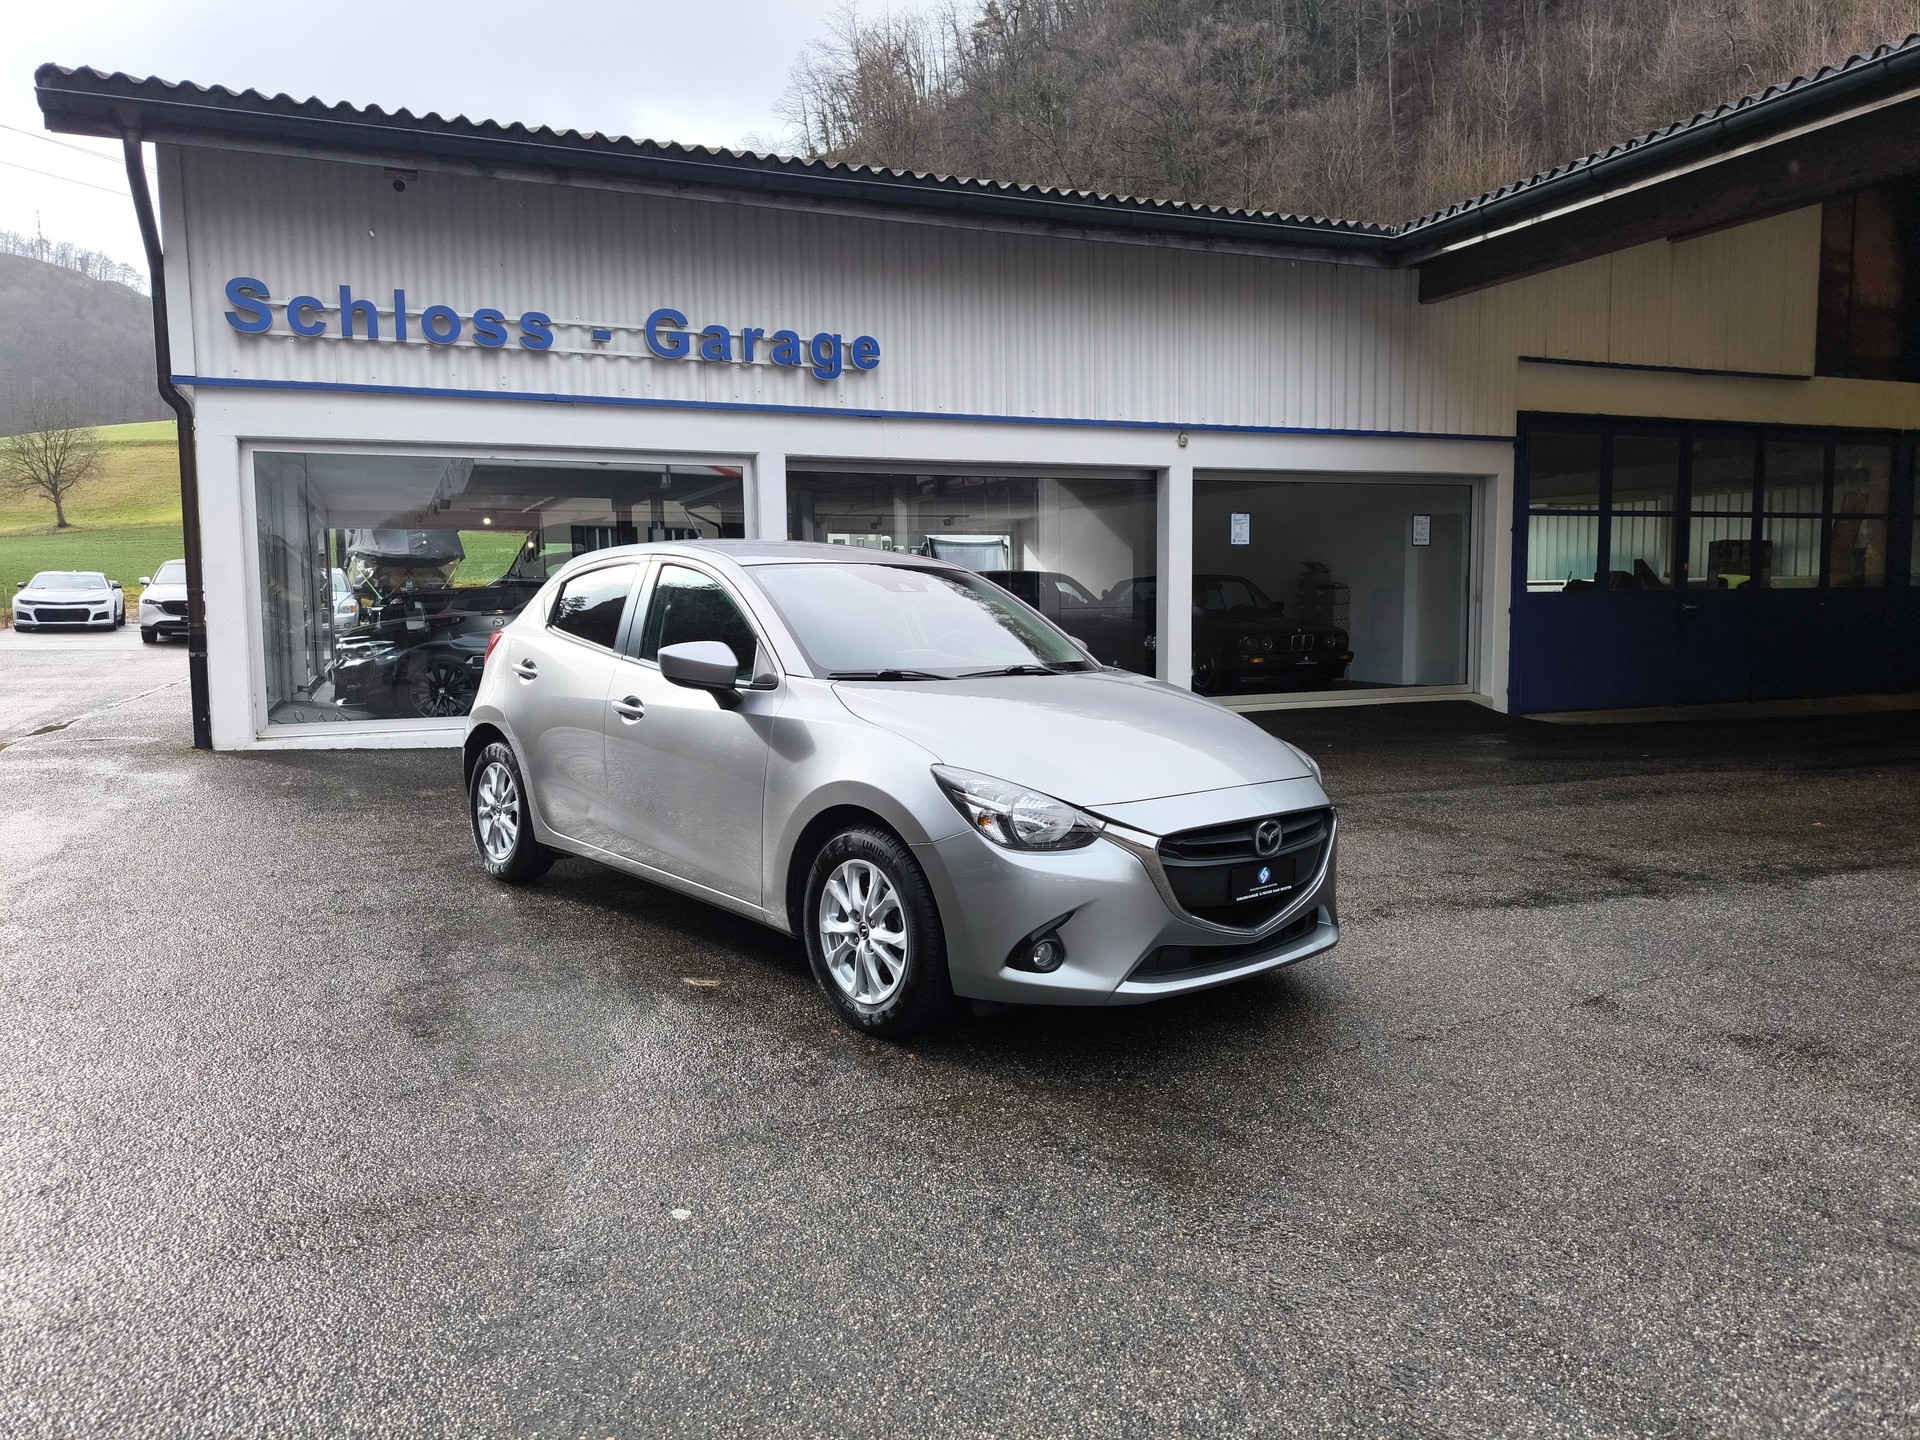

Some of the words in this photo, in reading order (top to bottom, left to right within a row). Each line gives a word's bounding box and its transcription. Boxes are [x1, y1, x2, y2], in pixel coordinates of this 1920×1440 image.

[224, 277, 554, 350] Schloss
[592, 329, 612, 342] -
[645, 308, 881, 380] Garage
